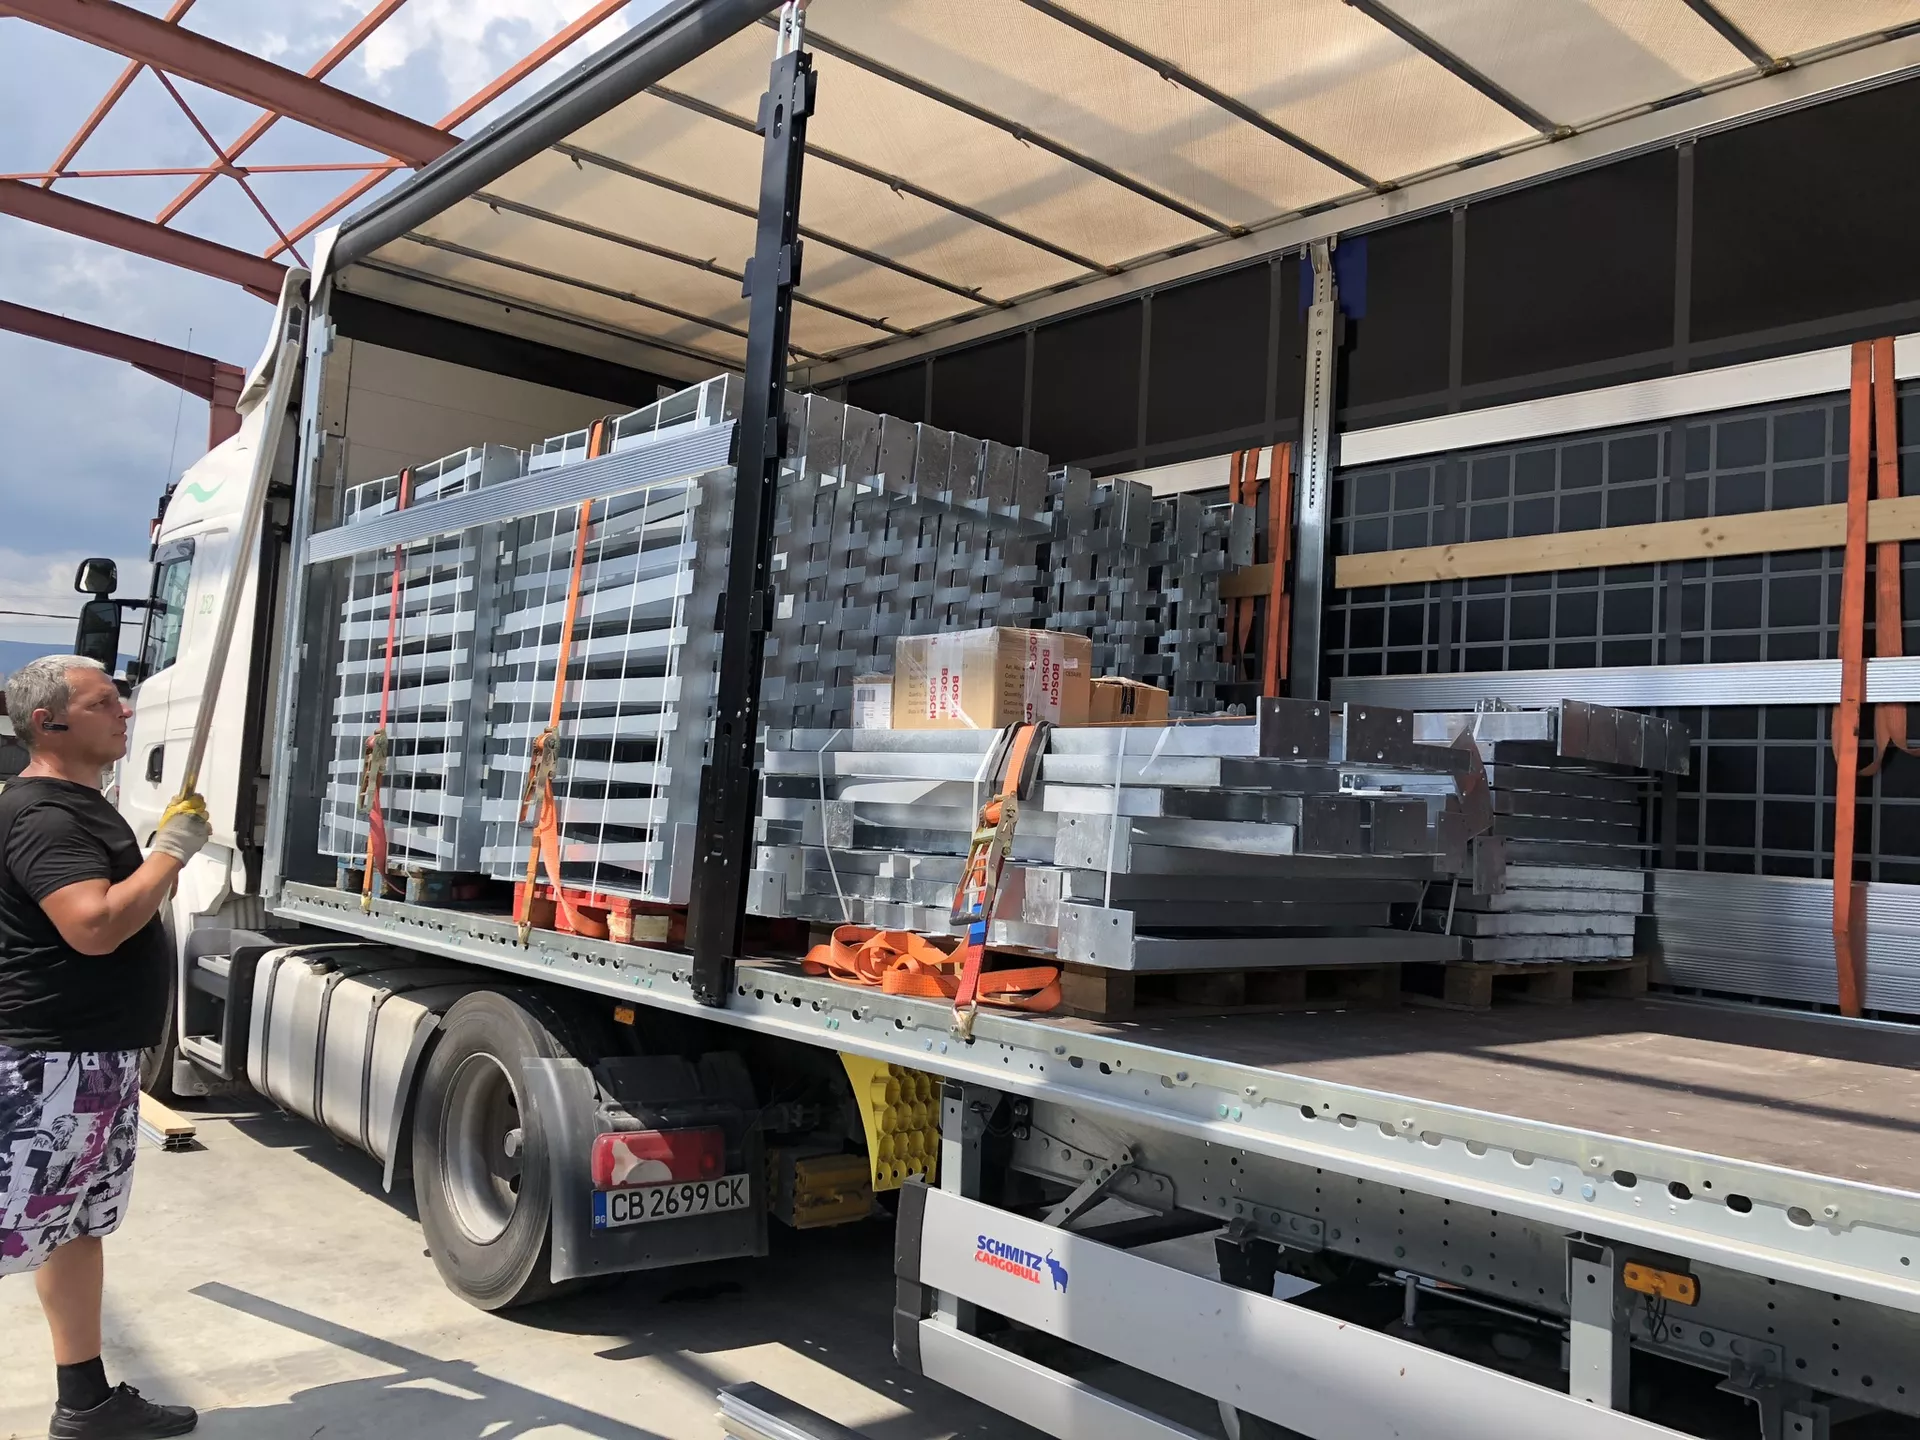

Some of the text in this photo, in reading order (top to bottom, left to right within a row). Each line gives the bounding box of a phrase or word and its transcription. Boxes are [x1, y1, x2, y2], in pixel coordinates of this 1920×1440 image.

[940, 668, 949, 710] BOSCH
[1042, 649, 1050, 691] BOSCH
[1050, 663, 1060, 706] BOSCH
[595, 1215, 606, 1225] BG
[611, 1178, 744, 1222] CB 2699 CK
[975, 1250, 1041, 1284] CARGOBULL
[977, 1235, 1043, 1271] SCHMITZ
